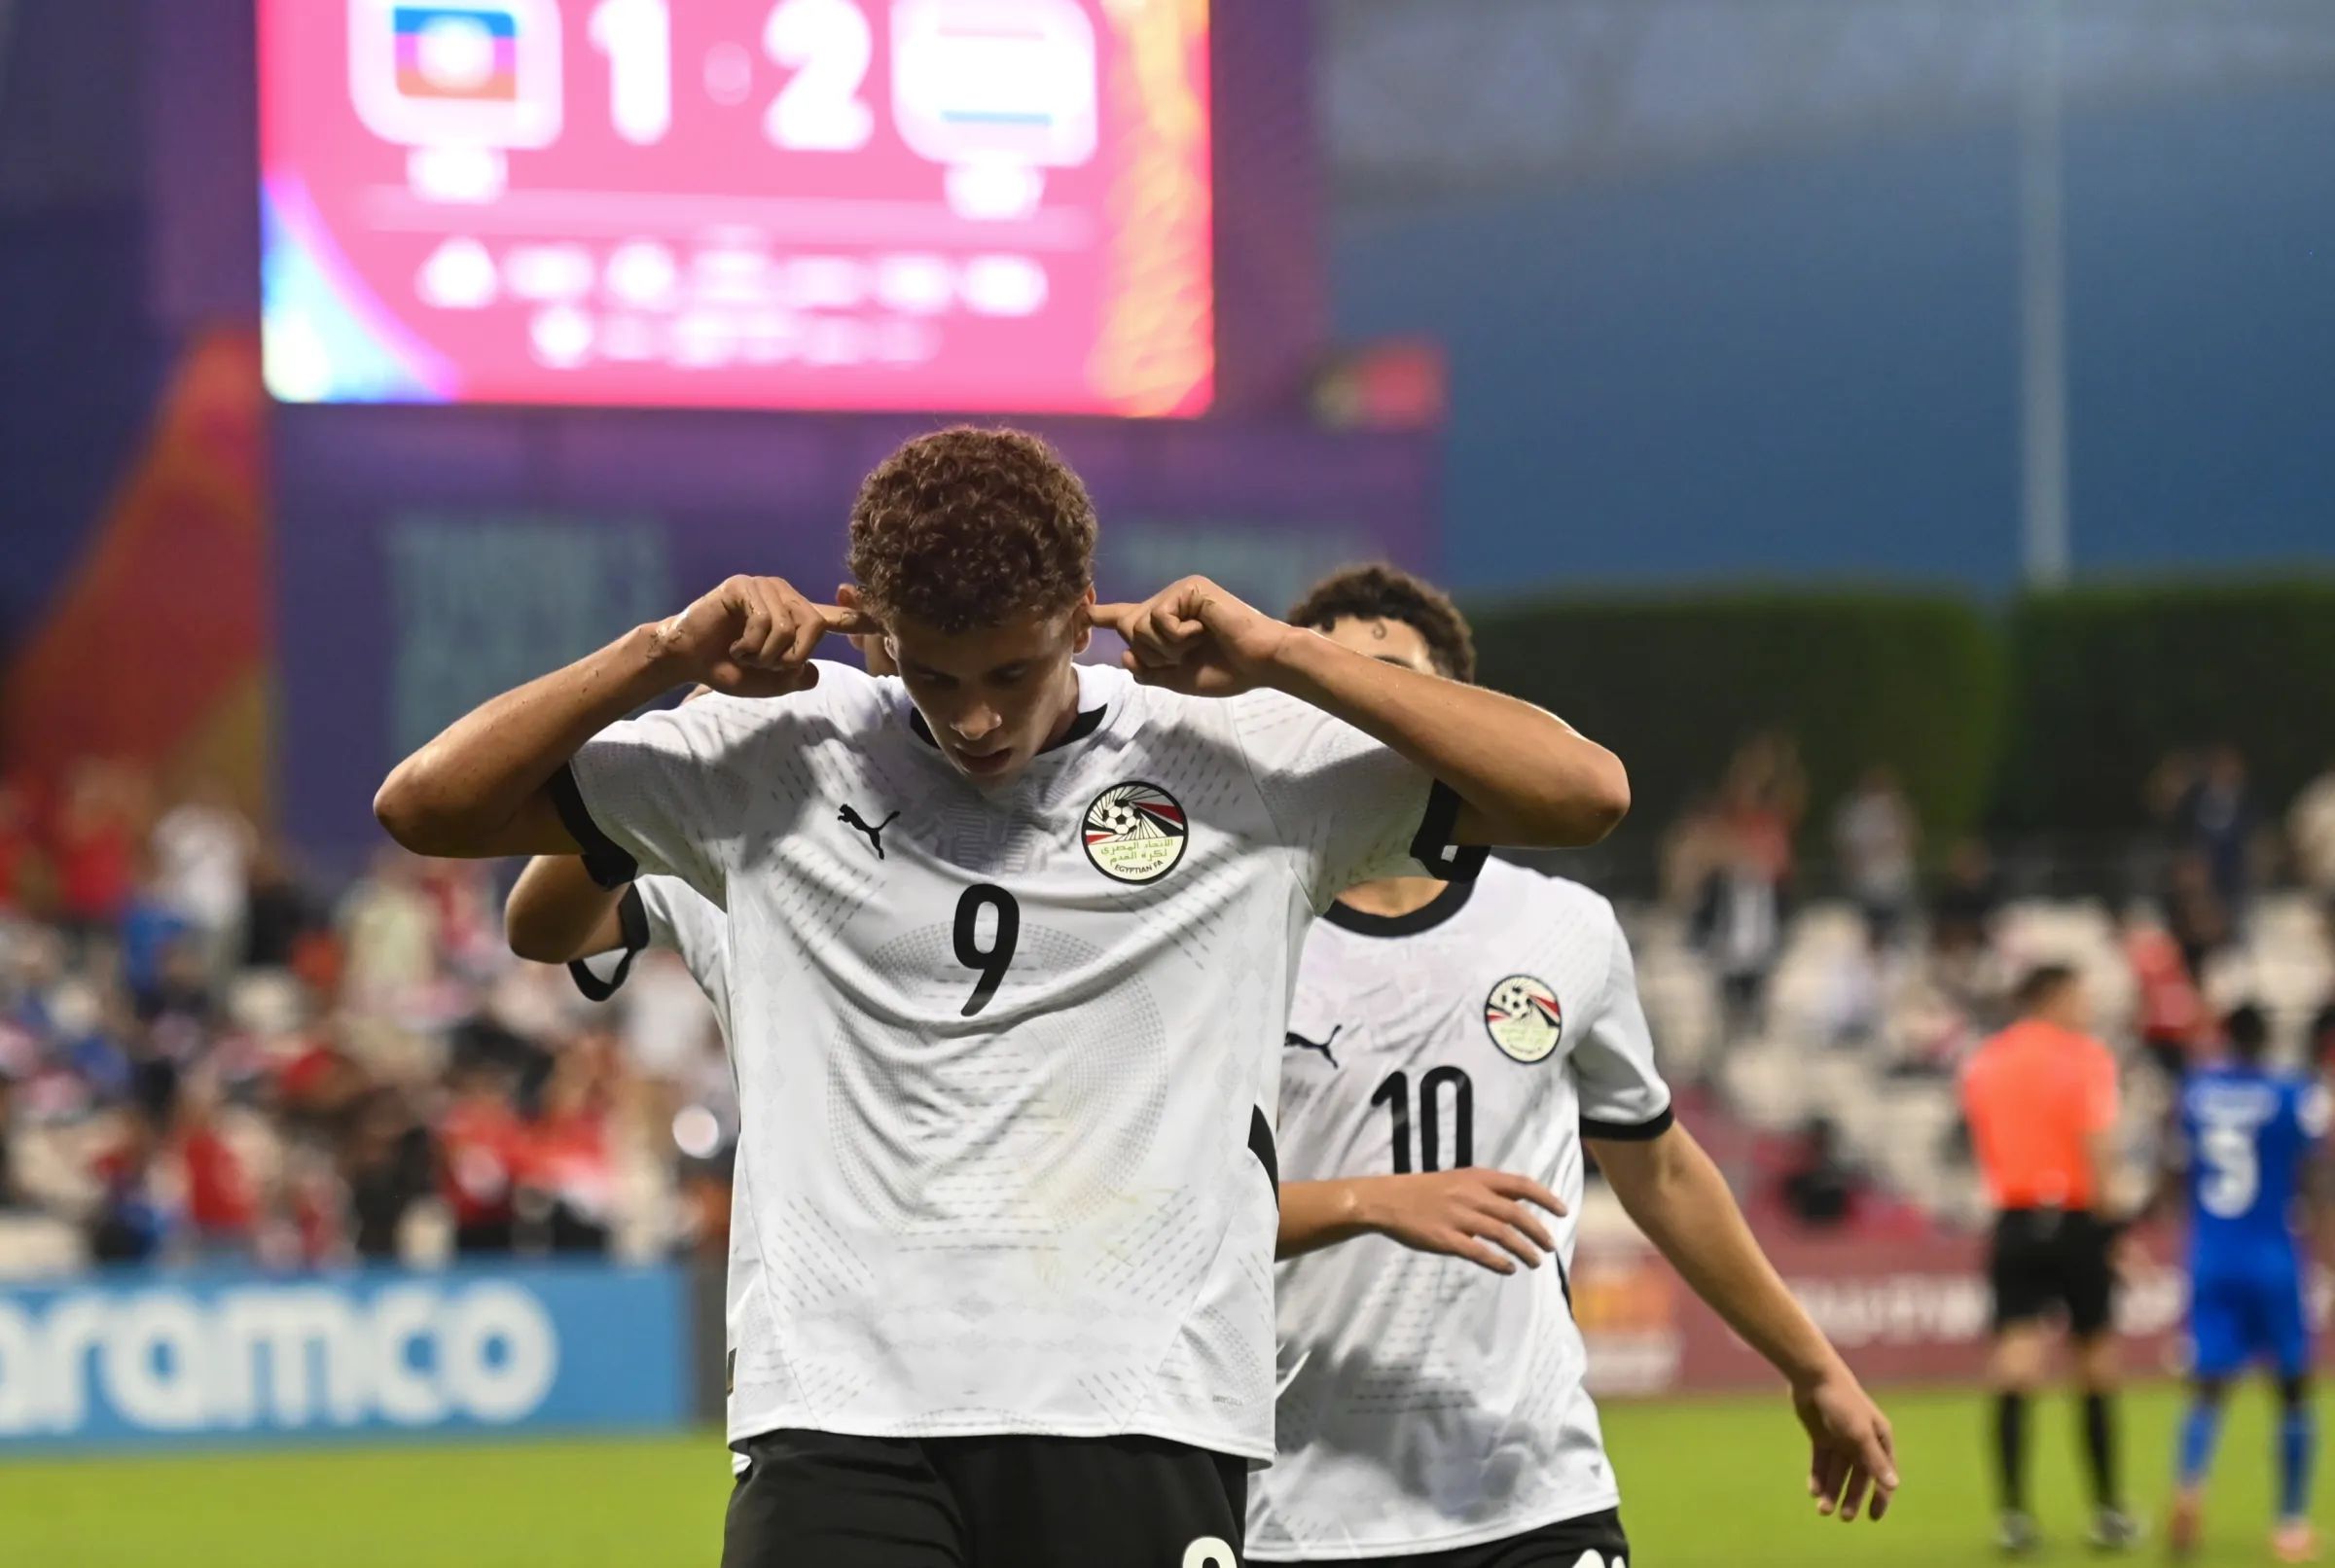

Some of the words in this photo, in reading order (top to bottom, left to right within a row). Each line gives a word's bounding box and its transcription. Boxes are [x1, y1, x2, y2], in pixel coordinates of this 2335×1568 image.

[588, 0, 671, 143] 1
[763, 0, 874, 150] 2
[1114, 864, 1152, 873] EGYPTIAN
[953, 883, 1020, 1013] 9
[1371, 1065, 1473, 1174] 10
